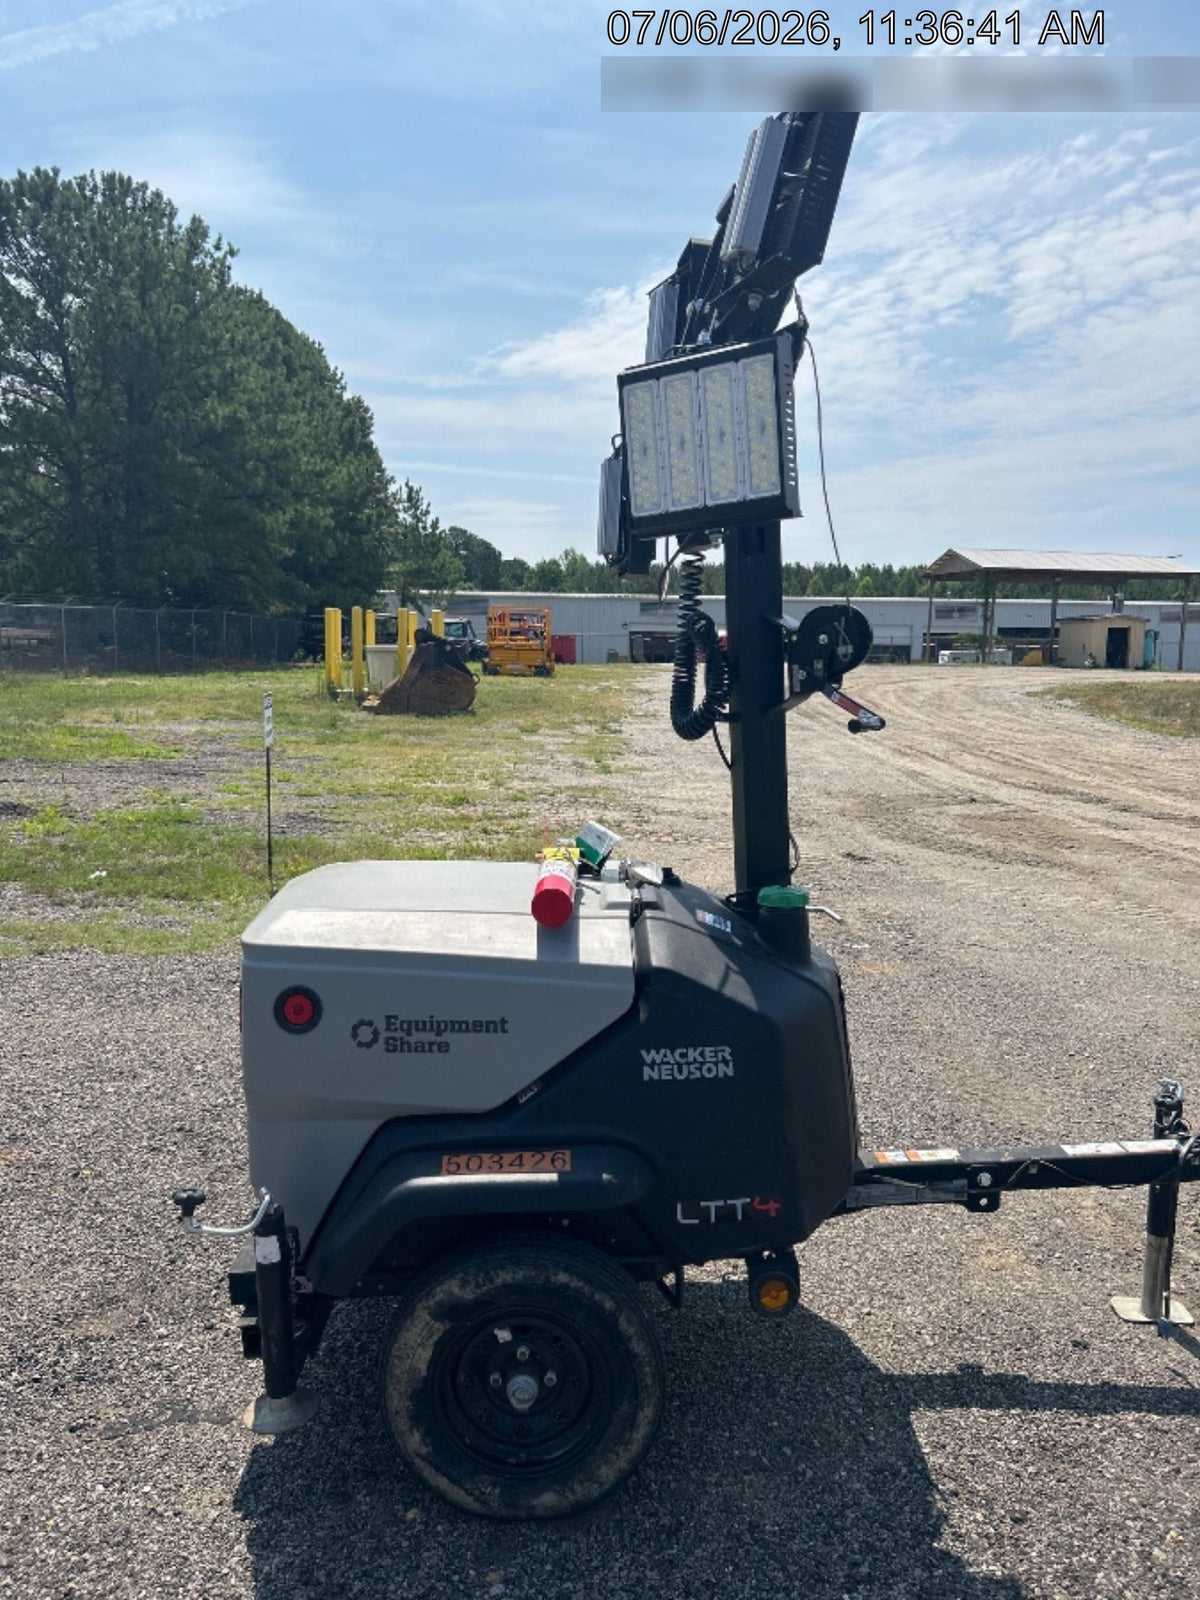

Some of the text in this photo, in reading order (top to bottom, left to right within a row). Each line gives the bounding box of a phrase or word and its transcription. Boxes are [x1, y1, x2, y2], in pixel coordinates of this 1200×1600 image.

[384, 1015, 509, 1036] Equipment
[384, 1036, 450, 1054] Share
[640, 1045, 732, 1064] WACKER
[643, 1061, 734, 1081] NEUSON
[445, 1151, 567, 1174] 503426
[677, 1196, 780, 1223] LTT4
